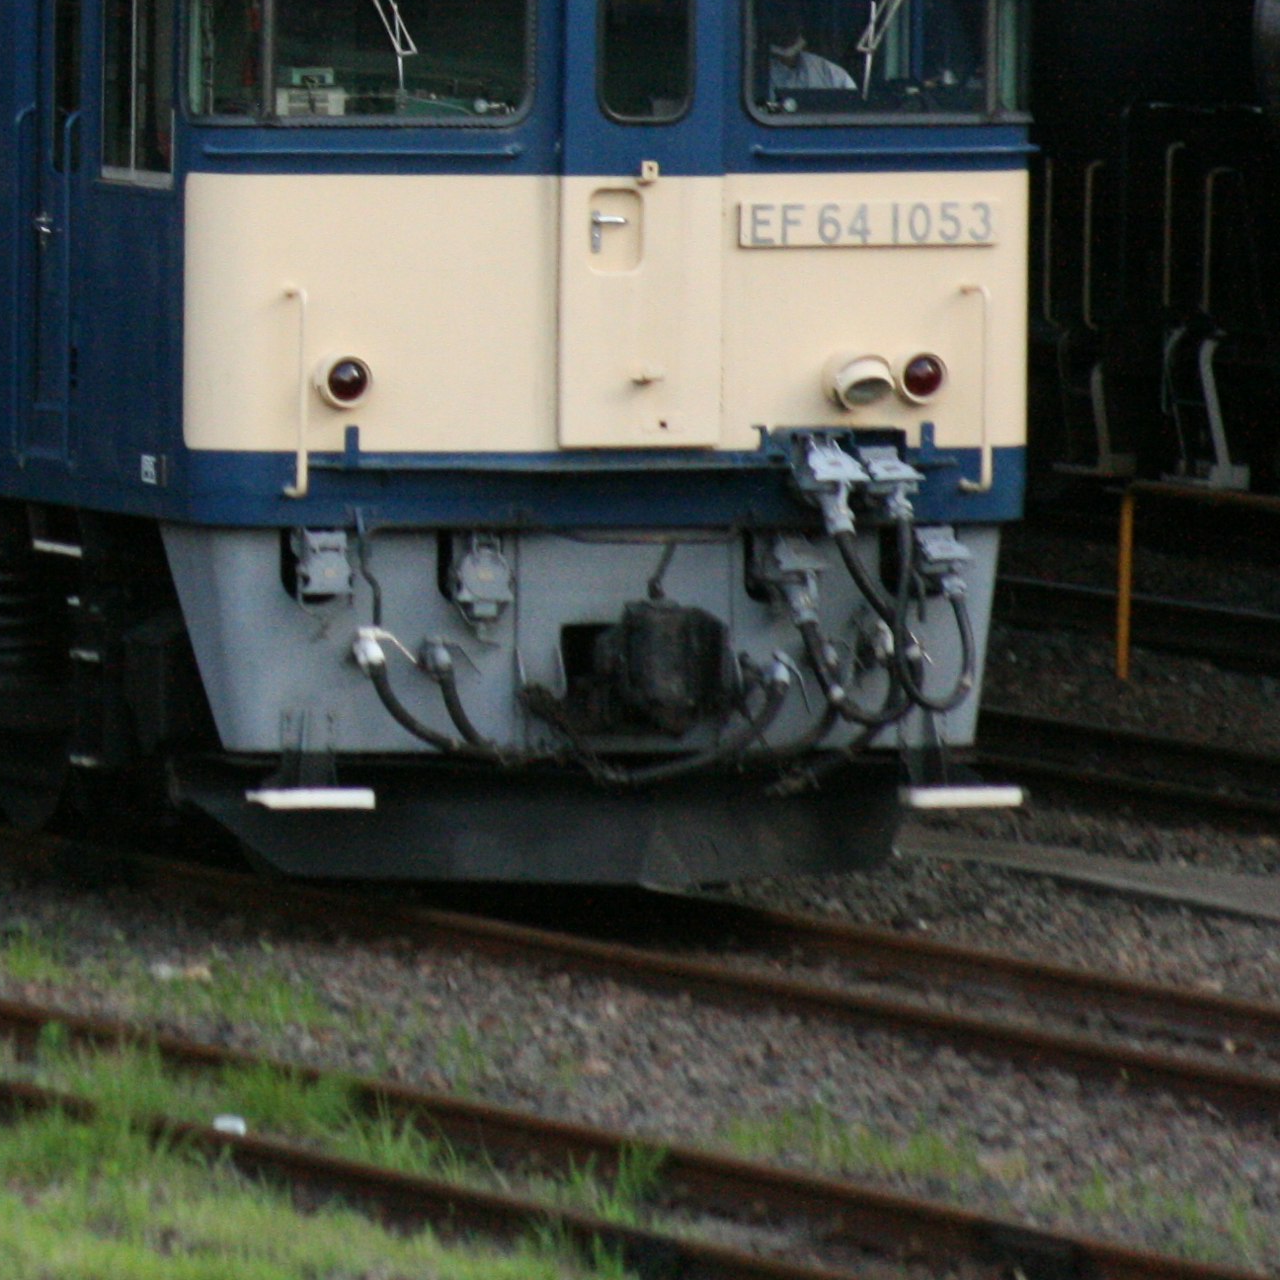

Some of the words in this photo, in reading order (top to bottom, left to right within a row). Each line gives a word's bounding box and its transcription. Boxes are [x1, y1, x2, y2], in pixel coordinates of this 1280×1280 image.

[750, 203, 806, 246] EF
[818, 203, 872, 245] 64
[891, 201, 993, 244] 1053
